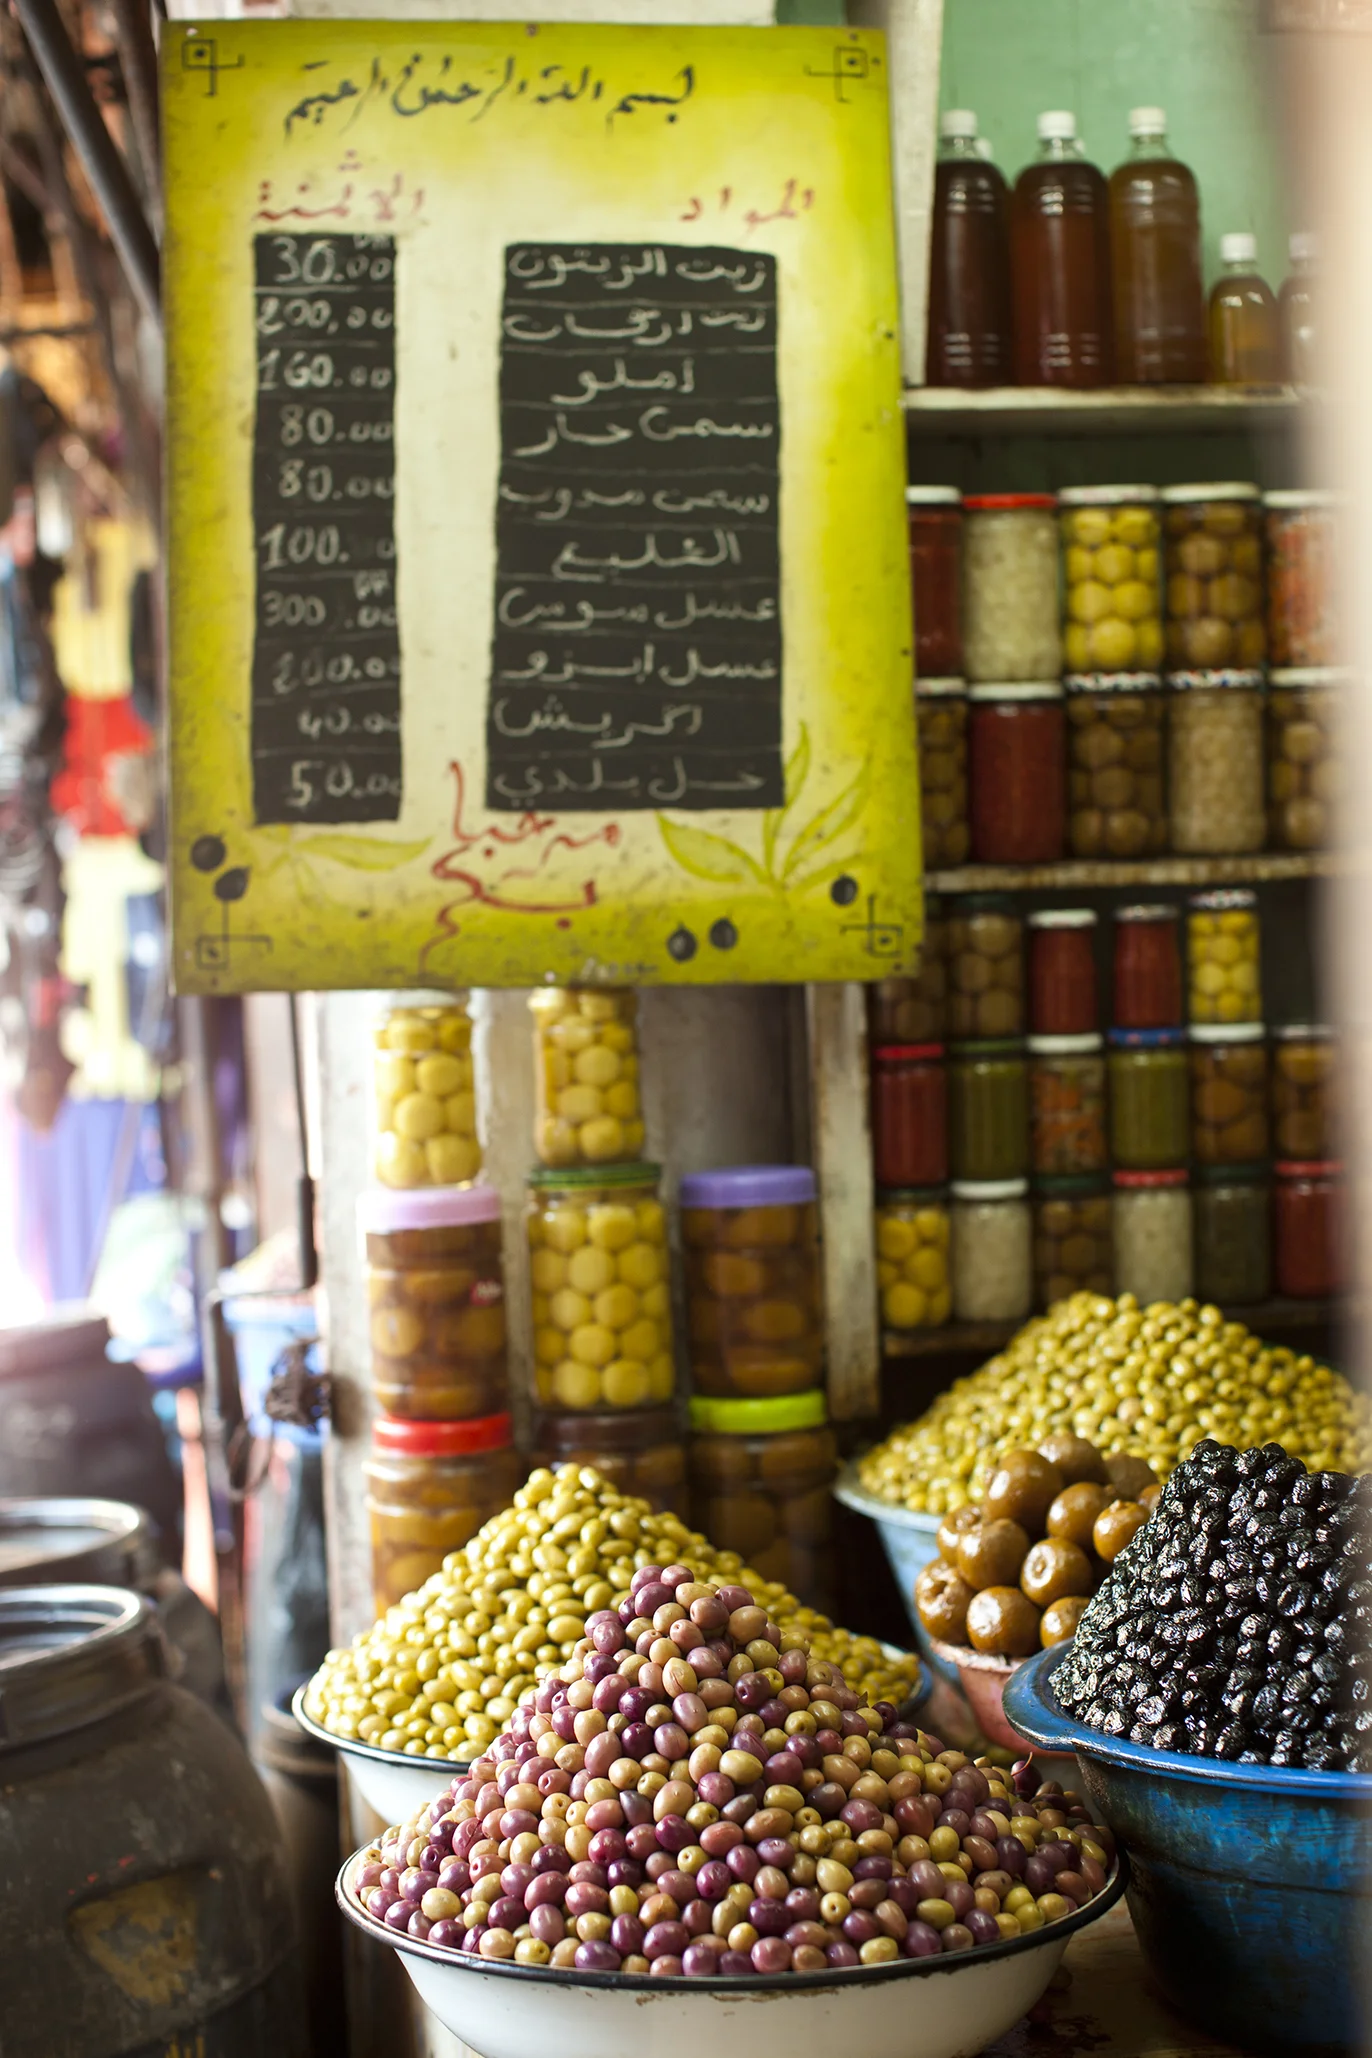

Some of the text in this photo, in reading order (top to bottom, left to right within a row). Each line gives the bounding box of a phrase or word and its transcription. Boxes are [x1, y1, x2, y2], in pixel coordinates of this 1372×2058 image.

[604, 63, 695, 141] بسم
[508, 247, 768, 293] زيت الزيتون
